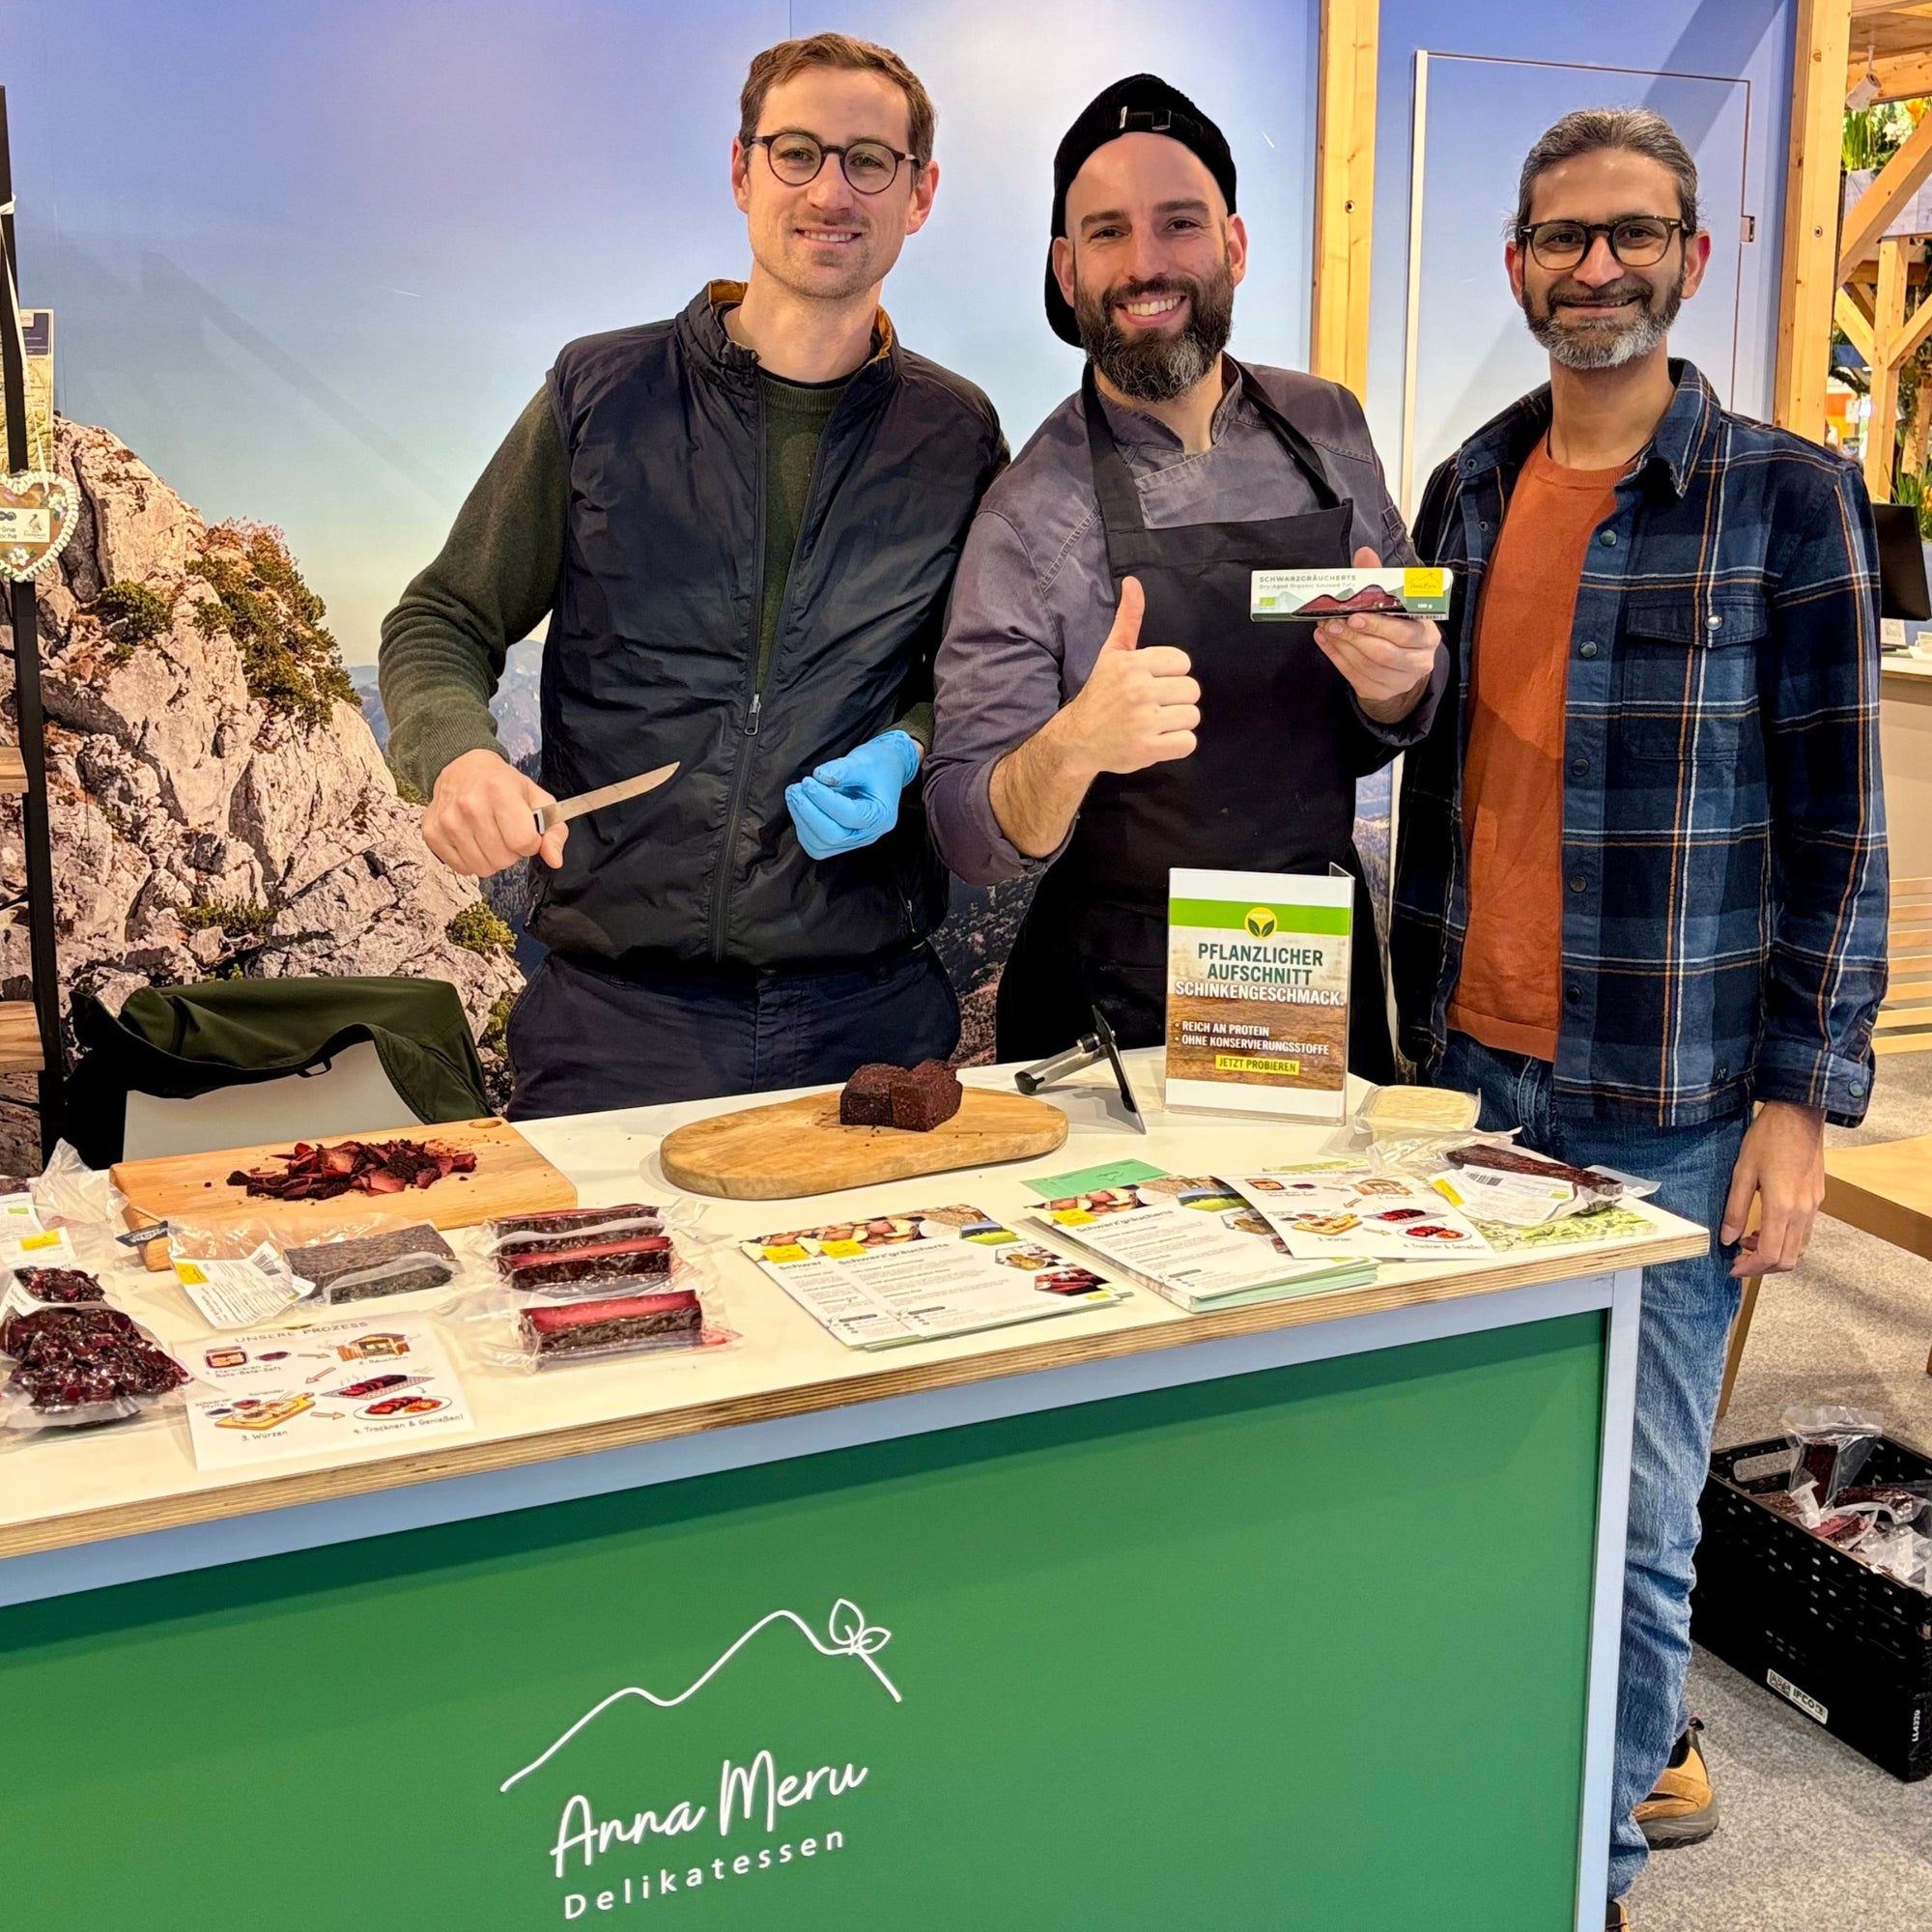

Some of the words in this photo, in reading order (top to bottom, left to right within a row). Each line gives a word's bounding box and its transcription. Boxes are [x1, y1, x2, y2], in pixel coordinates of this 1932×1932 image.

[1198, 943, 1323, 967] PFLANZLICHER
[1207, 963, 1313, 985] AUFSCHNITT
[1175, 980, 1345, 1007] SCHINKENGESCHMACK.
[1181, 1020, 1210, 1033] REICH
[1212, 1023, 1227, 1035] AN
[1228, 1024, 1270, 1037] PROTEIN
[1181, 1034, 1208, 1046] OHNE
[1209, 1037, 1330, 1056] KONSERVIERUNGSSTOFFE
[1218, 1058, 1244, 1068] JETZT
[1245, 1059, 1296, 1073] PROBIEREN
[302, 1321, 369, 1335] PROZESS
[364, 1423, 406, 1433] Trocknen
[418, 1413, 465, 1426] Genießen!
[252, 1430, 288, 1439] Würzen
[1793, 1688, 1815, 1709] IFCO
[550, 1794, 706, 1878] Anna
[720, 1749, 868, 1836] Meru
[564, 1830, 843, 1919] Delikatessen
